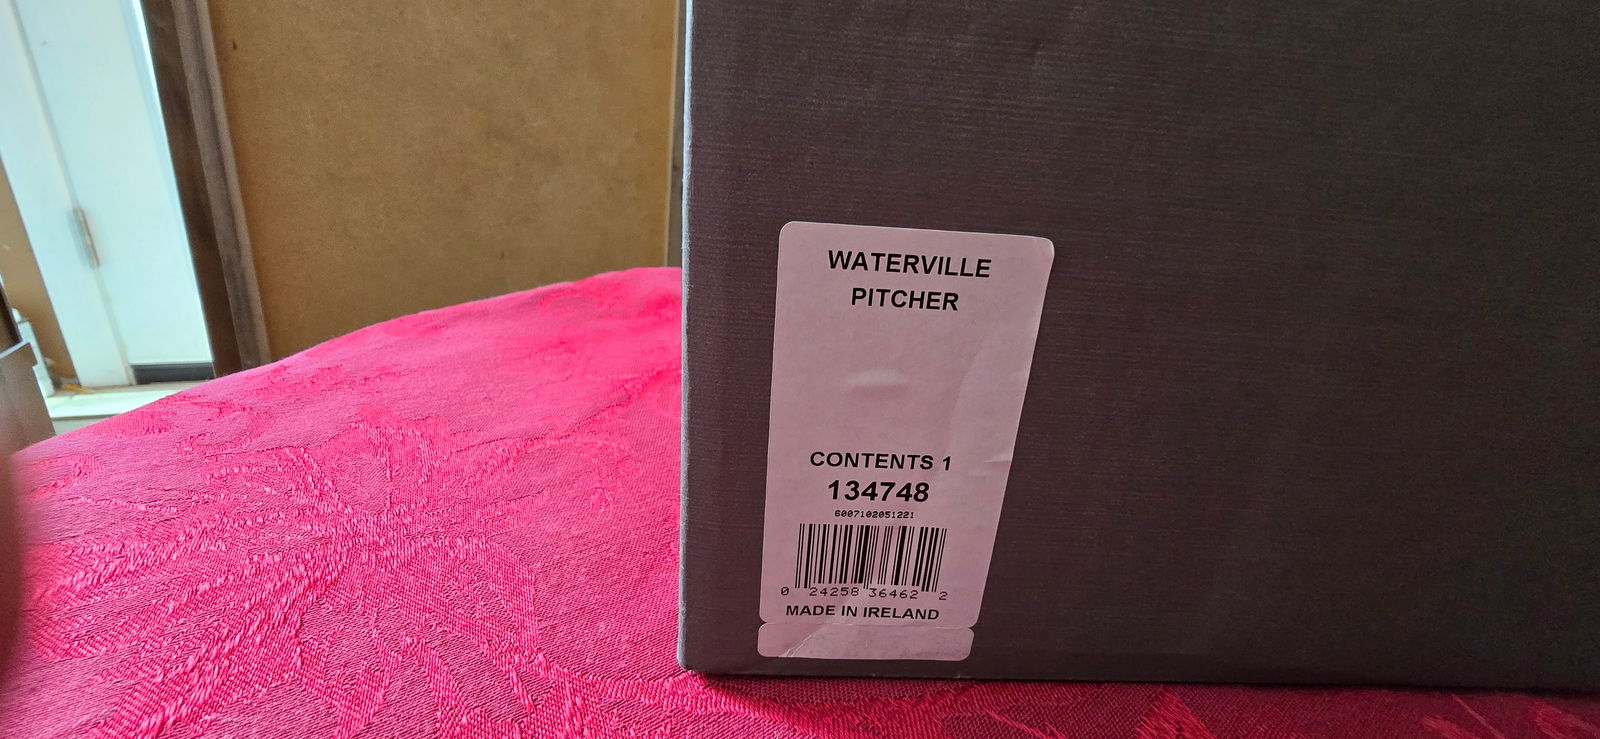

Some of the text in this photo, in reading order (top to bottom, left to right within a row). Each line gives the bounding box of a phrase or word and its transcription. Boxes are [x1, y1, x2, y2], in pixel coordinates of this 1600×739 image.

[828, 250, 992, 278] WATERVILLE
[851, 287, 960, 312] PITCHER
[810, 451, 952, 471] CONTENTS 1
[828, 480, 930, 502] 134748
[834, 509, 915, 519] 6007102051221
[780, 586, 948, 601] 0 24258 36462 2
[786, 605, 940, 620] MADE IN IRELAND
